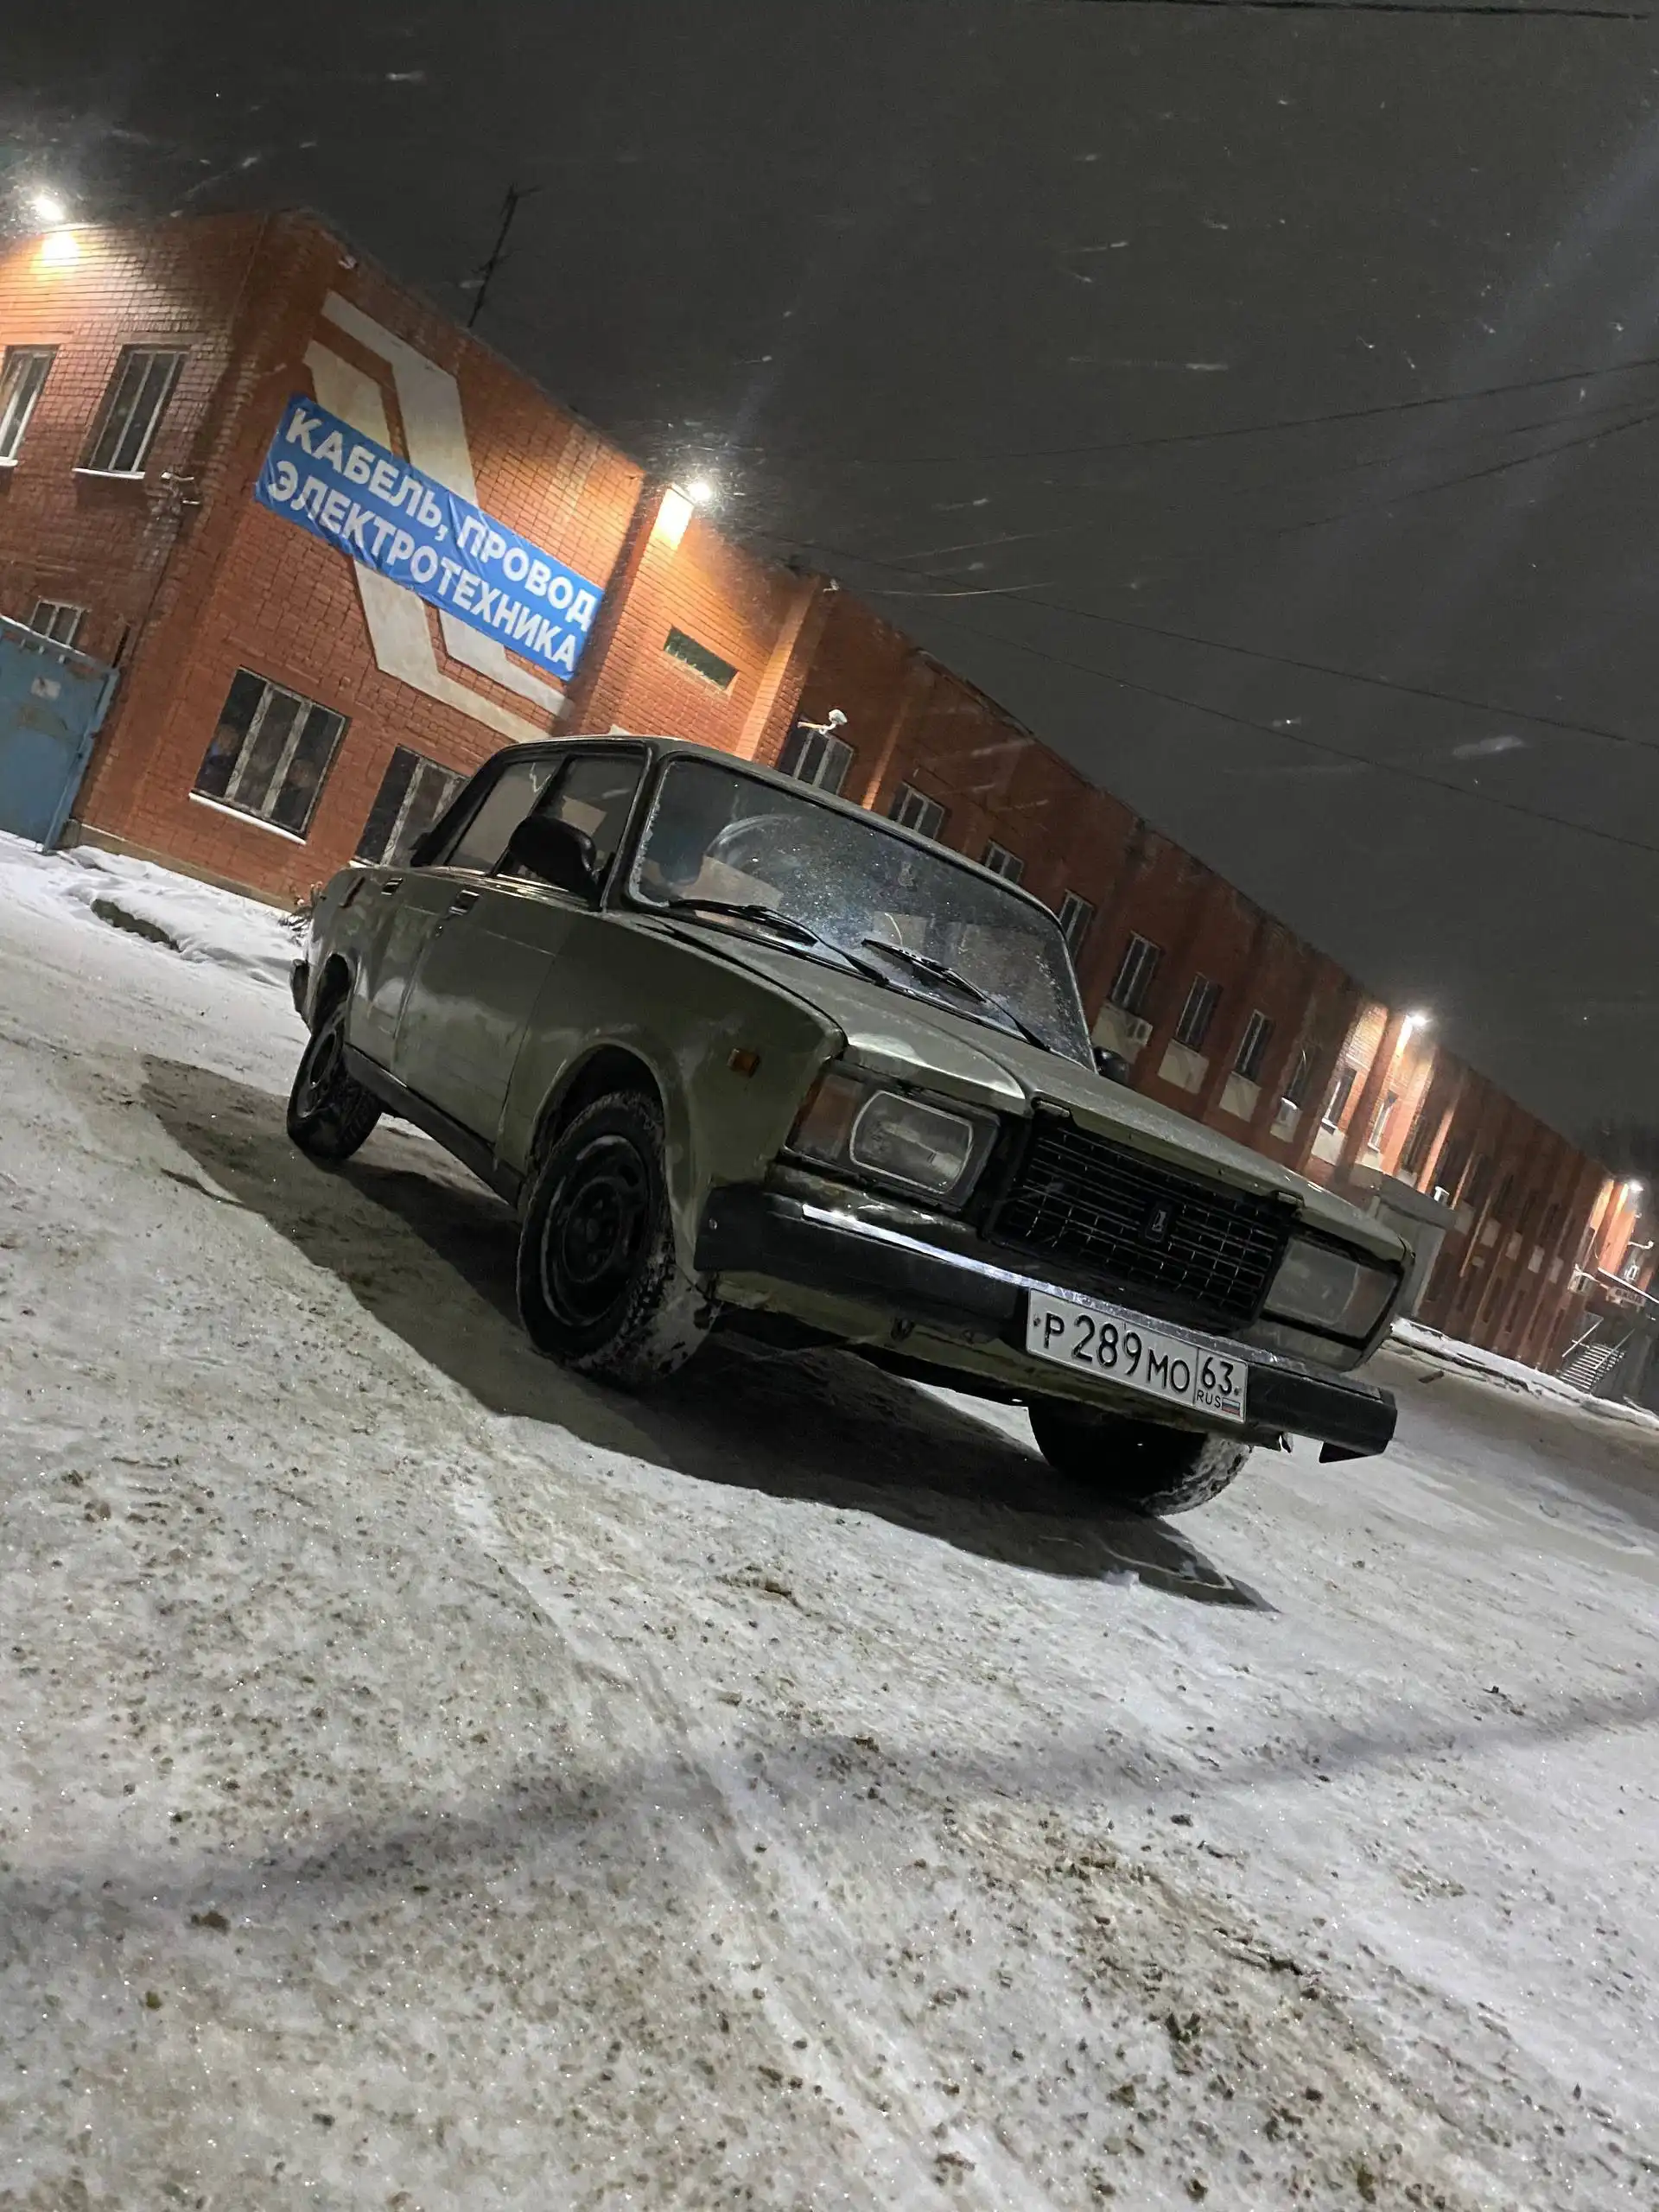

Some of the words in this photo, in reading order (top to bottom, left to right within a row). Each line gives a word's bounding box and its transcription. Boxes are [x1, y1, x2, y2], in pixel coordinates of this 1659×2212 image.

[268, 461, 577, 671] ЭЛЕКТРОТЕХНИКА
[287, 409, 447, 541] КАБЕЛЬ,
[458, 516, 598, 632] ПРОВОД
[1196, 1389, 1221, 1408] RUS
[1202, 1357, 1234, 1394] 63
